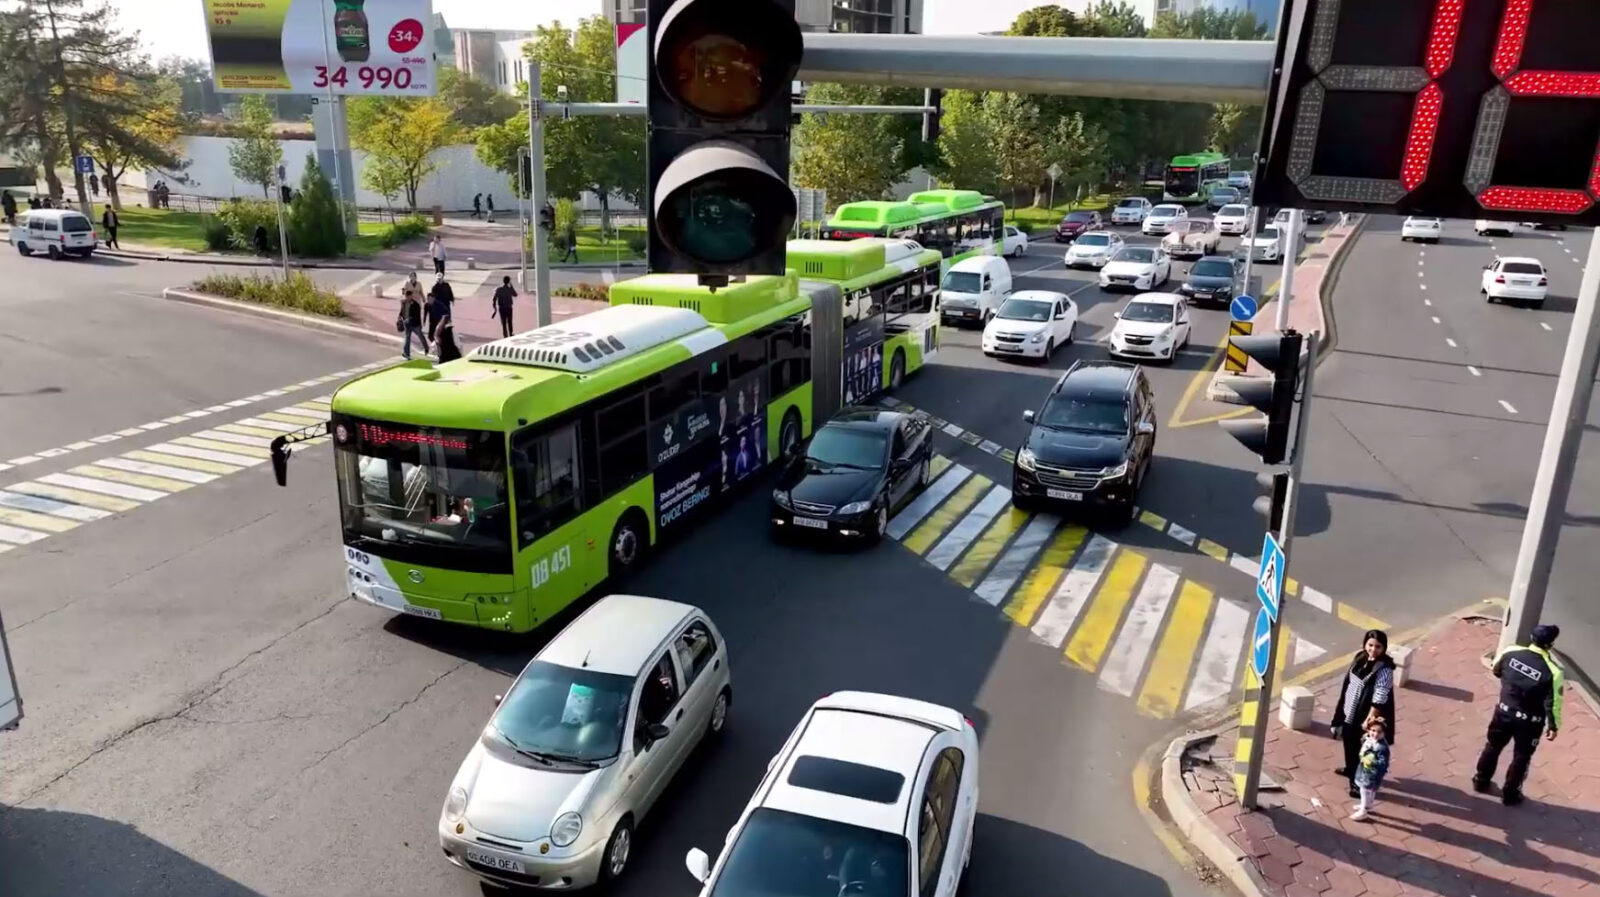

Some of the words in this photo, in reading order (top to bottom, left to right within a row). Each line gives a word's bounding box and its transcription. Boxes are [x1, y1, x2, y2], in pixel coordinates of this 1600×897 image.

[313, 66, 348, 88] 34
[358, 66, 412, 89] 990
[660, 503, 682, 527] OVOZ
[551, 545, 571, 574] 451
